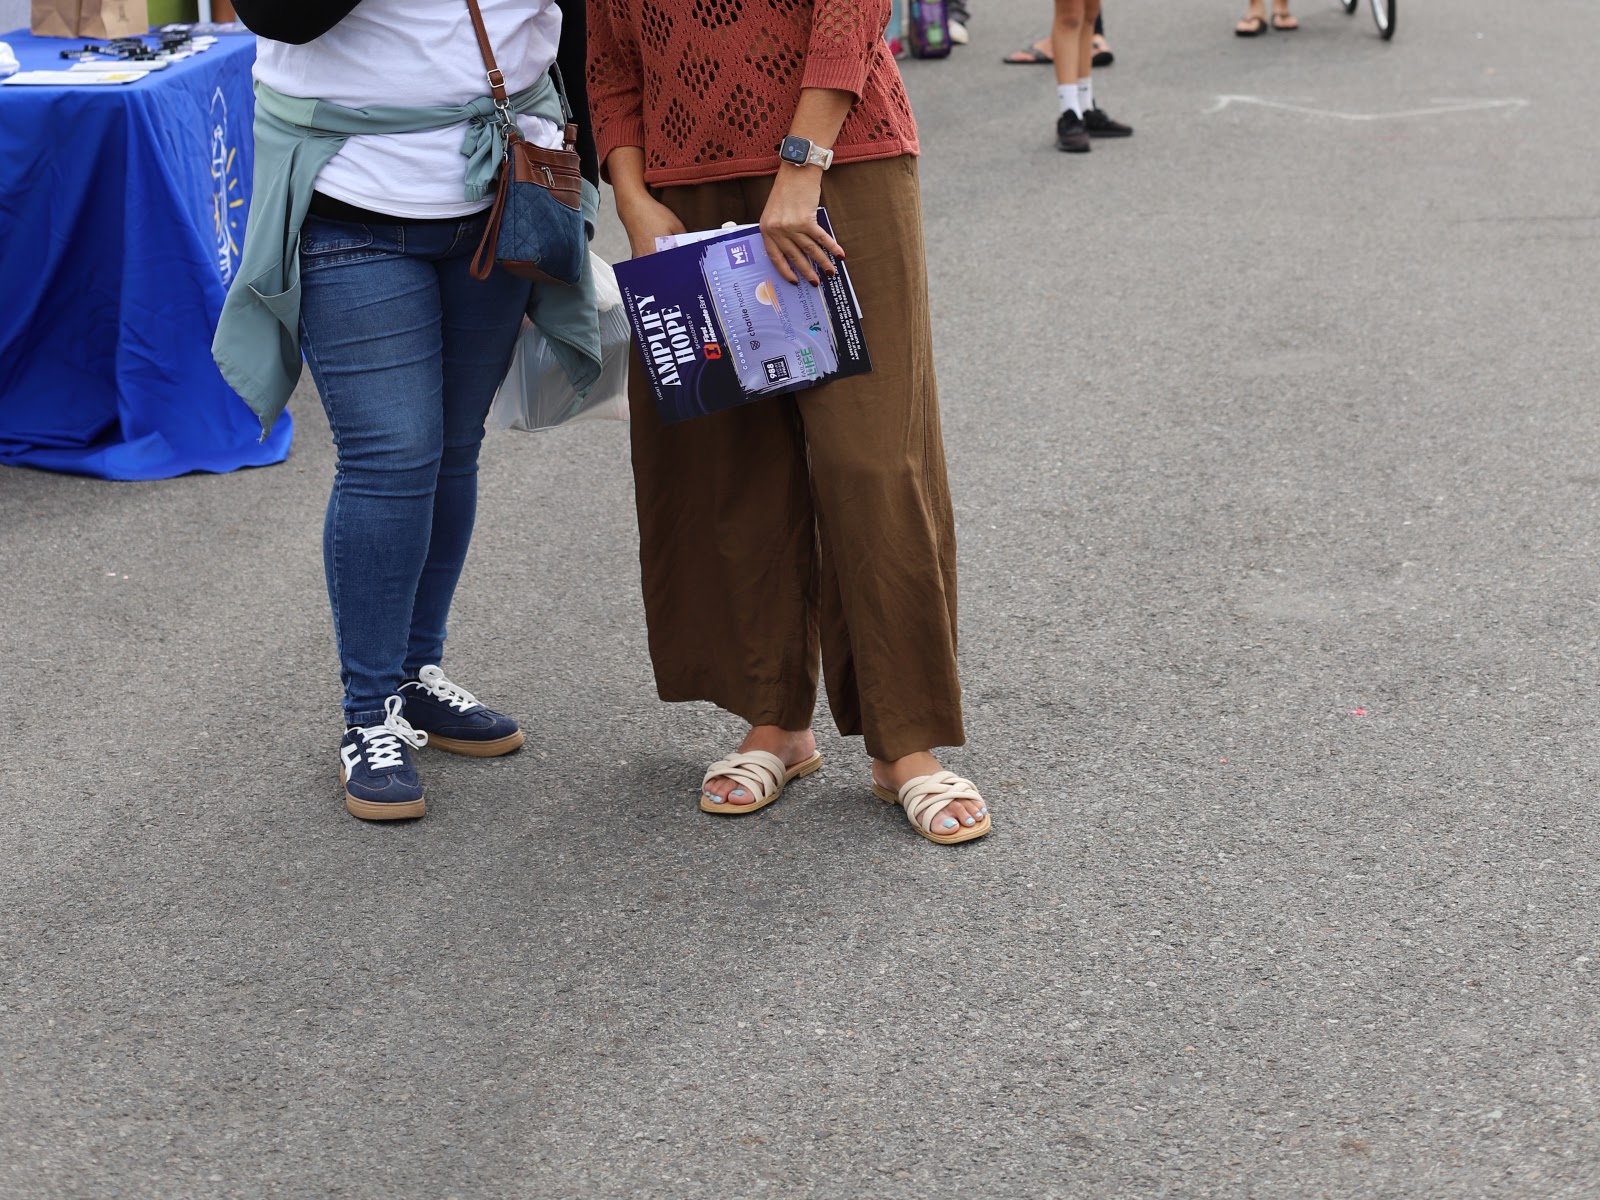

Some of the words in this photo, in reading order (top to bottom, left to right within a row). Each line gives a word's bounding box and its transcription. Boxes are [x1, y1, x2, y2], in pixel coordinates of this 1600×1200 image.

[730, 246, 745, 264] ME
[624, 286, 635, 312] PRESENTS
[696, 294, 706, 309] Bank
[712, 270, 729, 313] PARTNERS
[732, 282, 745, 308] health
[774, 283, 785, 306] HEALTH
[804, 286, 817, 318] BEHAVIORAL
[741, 308, 755, 336] charlie
[799, 299, 811, 320] Inland
[631, 313, 644, 341] NONPROFIT
[660, 304, 696, 364] HOPE
[687, 320, 700, 349] SPONSORED
[699, 326, 710, 342] First
[702, 308, 717, 342] Interstate
[850, 325, 859, 344] SUPPORT
[634, 294, 681, 385] AMPLIFY
[727, 320, 747, 370] COMMUNITY
[846, 338, 854, 356] SPECIAL
[648, 366, 656, 380] LAMP
[766, 363, 777, 378] 988
[799, 345, 817, 376] LIFE
[654, 386, 663, 400] LIGHT
